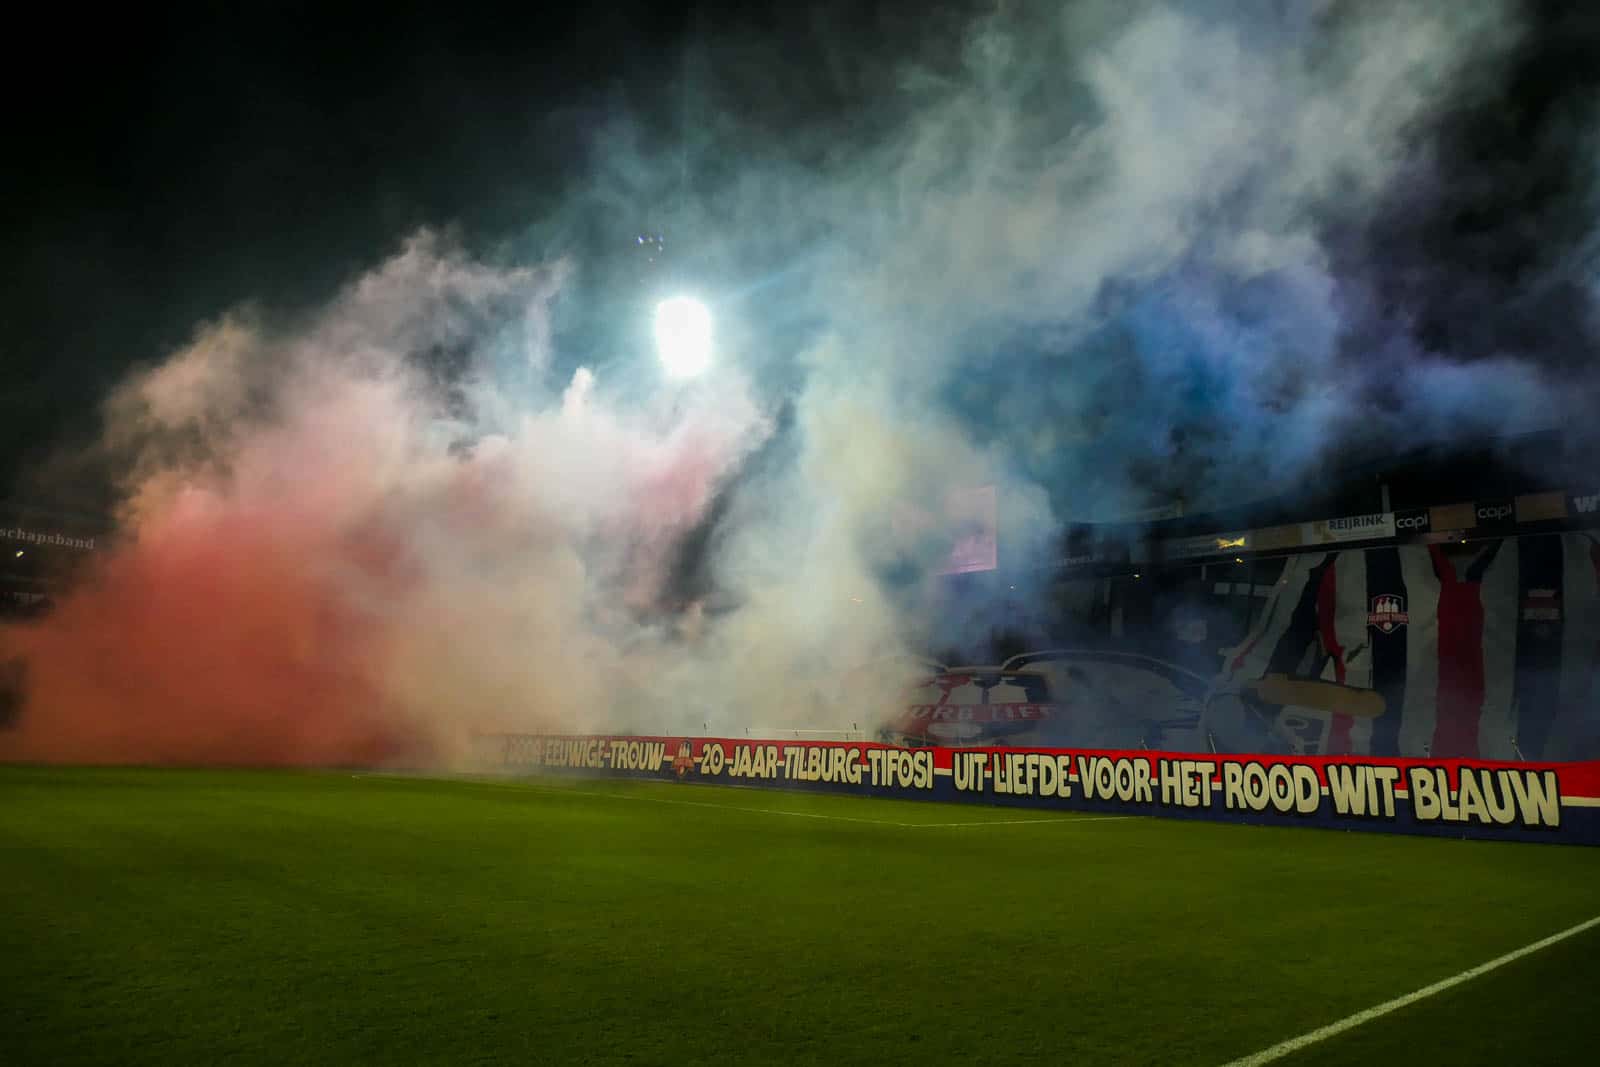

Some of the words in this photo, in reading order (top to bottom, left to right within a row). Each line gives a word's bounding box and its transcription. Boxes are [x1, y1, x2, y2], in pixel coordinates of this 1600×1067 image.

[1396, 513, 1429, 530] capi
[1477, 504, 1512, 521] capi
[545, 739, 605, 769] EEUWIGE
[609, 741, 665, 771] TROUW
[701, 743, 724, 775] 20
[728, 745, 777, 779] JAAR
[784, 746, 863, 785] TILBURG
[867, 749, 934, 789] TIFOSI
[953, 752, 988, 796] UIT
[993, 753, 1071, 799] LIEFDE
[1077, 756, 1152, 803] VOOR
[1160, 759, 1216, 808] HET
[1223, 761, 1320, 814] ROOD
[1327, 764, 1399, 817] WIT
[1410, 767, 1561, 828] BLAUW
